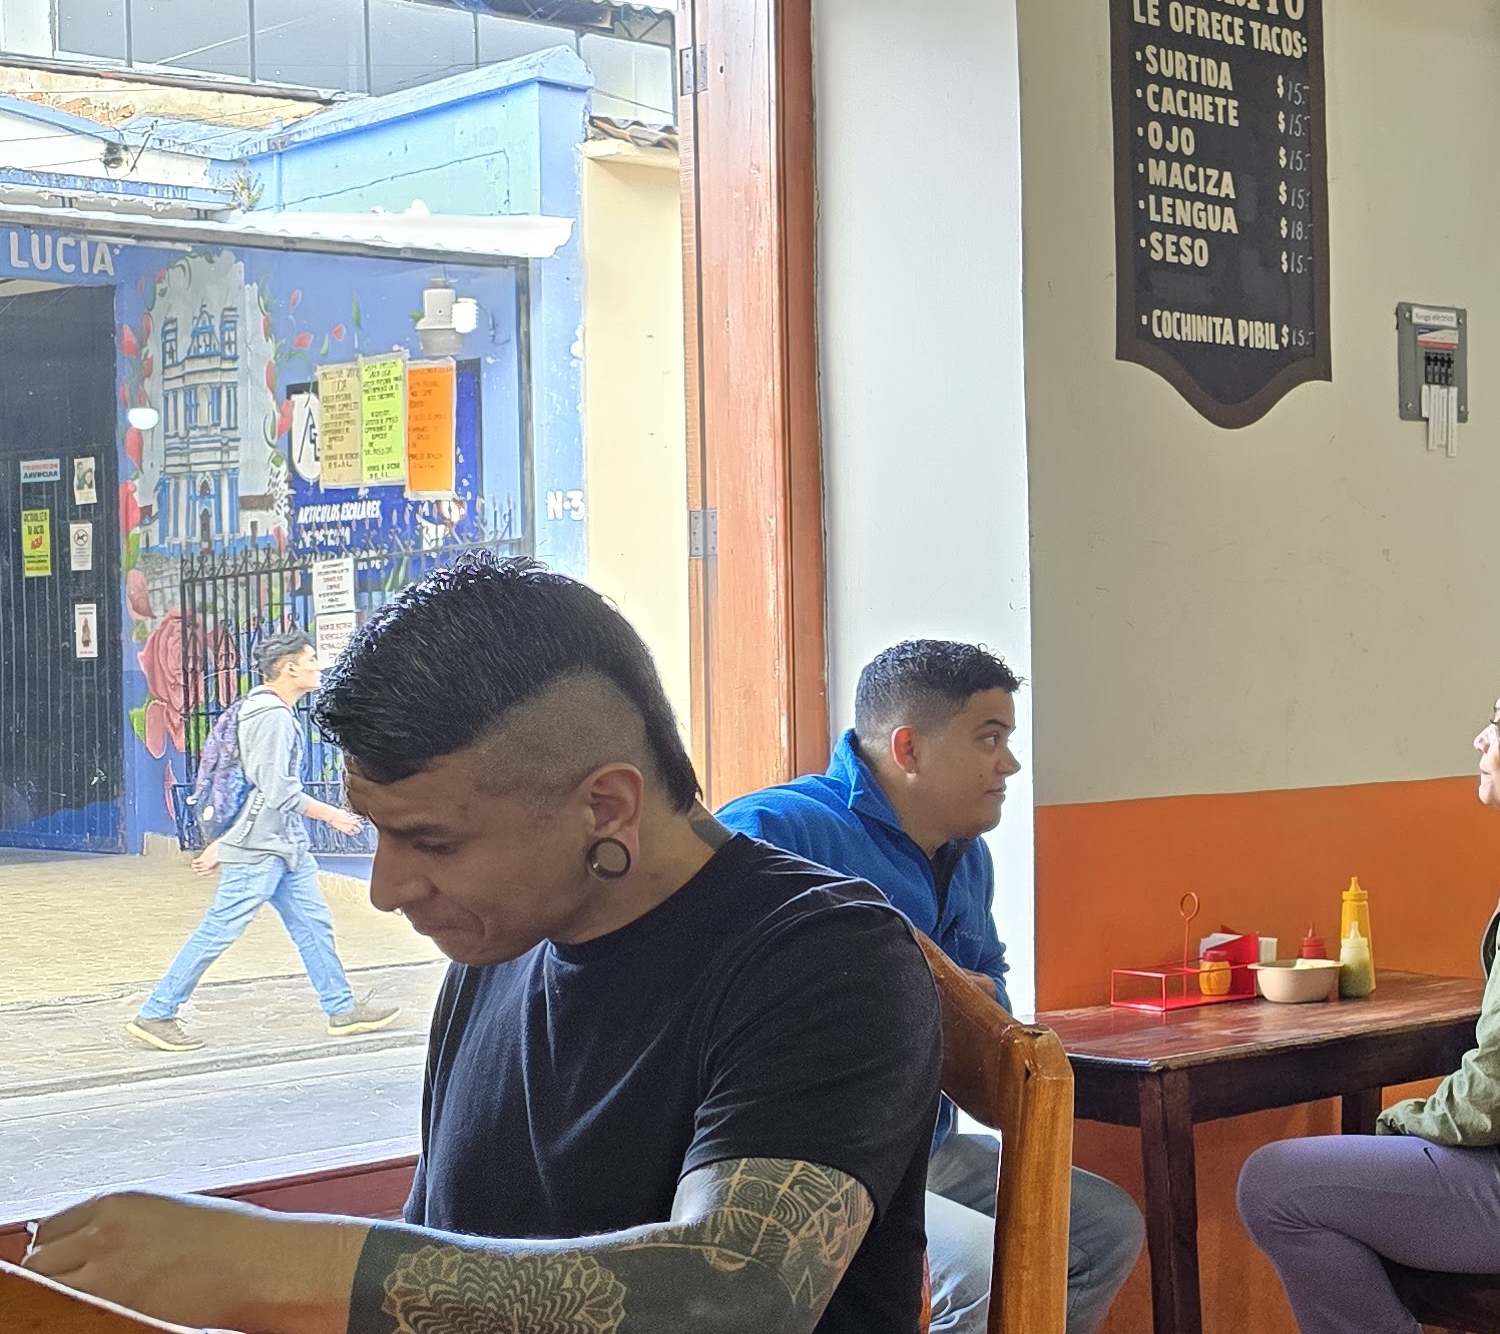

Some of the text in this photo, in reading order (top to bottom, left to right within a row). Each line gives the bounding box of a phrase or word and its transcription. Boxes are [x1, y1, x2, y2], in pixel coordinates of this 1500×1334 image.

[1168, 1, 1245, 47] OFRECE
[1249, 20, 1308, 59] TACOS:
[1145, 44, 1234, 92] SURTIDA
[1146, 83, 1239, 127] CACHETE
[1147, 120, 1196, 156] OJO
[1148, 157, 1237, 199] MACIZA
[1148, 194, 1240, 235] LENGUA
[9, 231, 115, 276] LUCIA
[1149, 230, 1209, 268] SESO
[1151, 308, 1235, 346] COCHINITA
[1238, 318, 1280, 351] PIBIL
